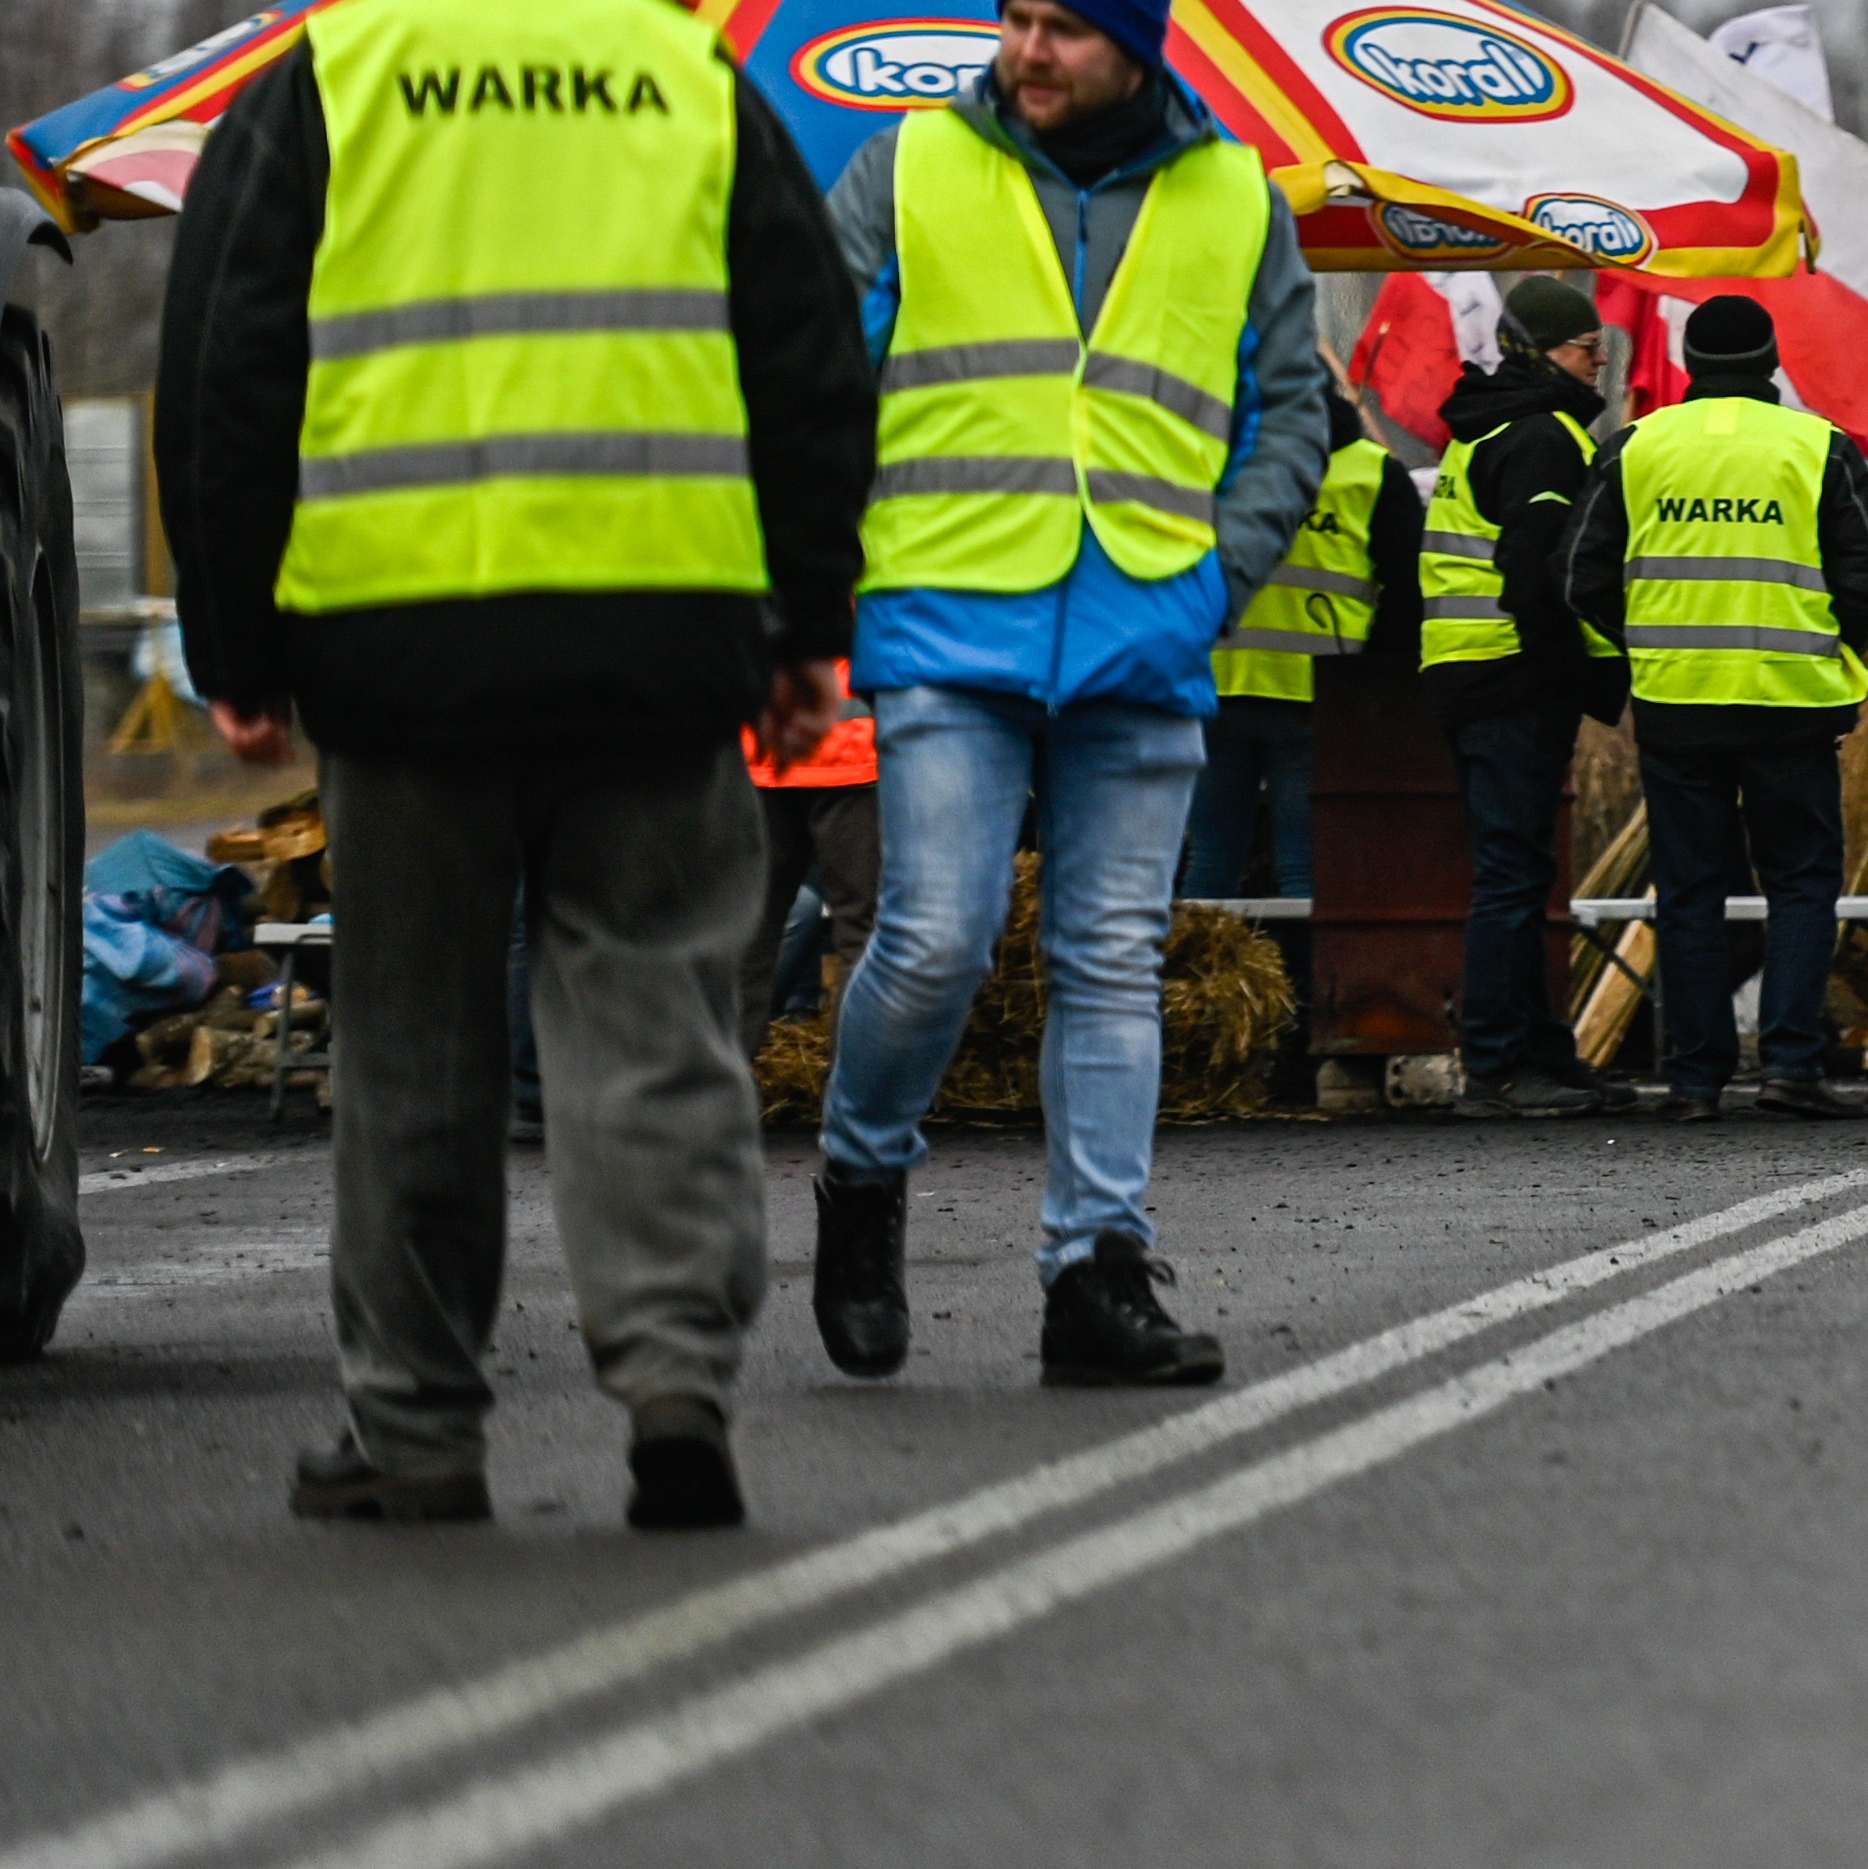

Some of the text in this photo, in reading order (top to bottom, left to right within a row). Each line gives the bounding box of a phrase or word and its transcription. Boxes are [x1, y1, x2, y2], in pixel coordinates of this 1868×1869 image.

[397, 61, 671, 117] WARKA
[854, 47, 986, 93] kor
[1362, 41, 1538, 100] koral
[1656, 498, 1784, 525] WARKA
